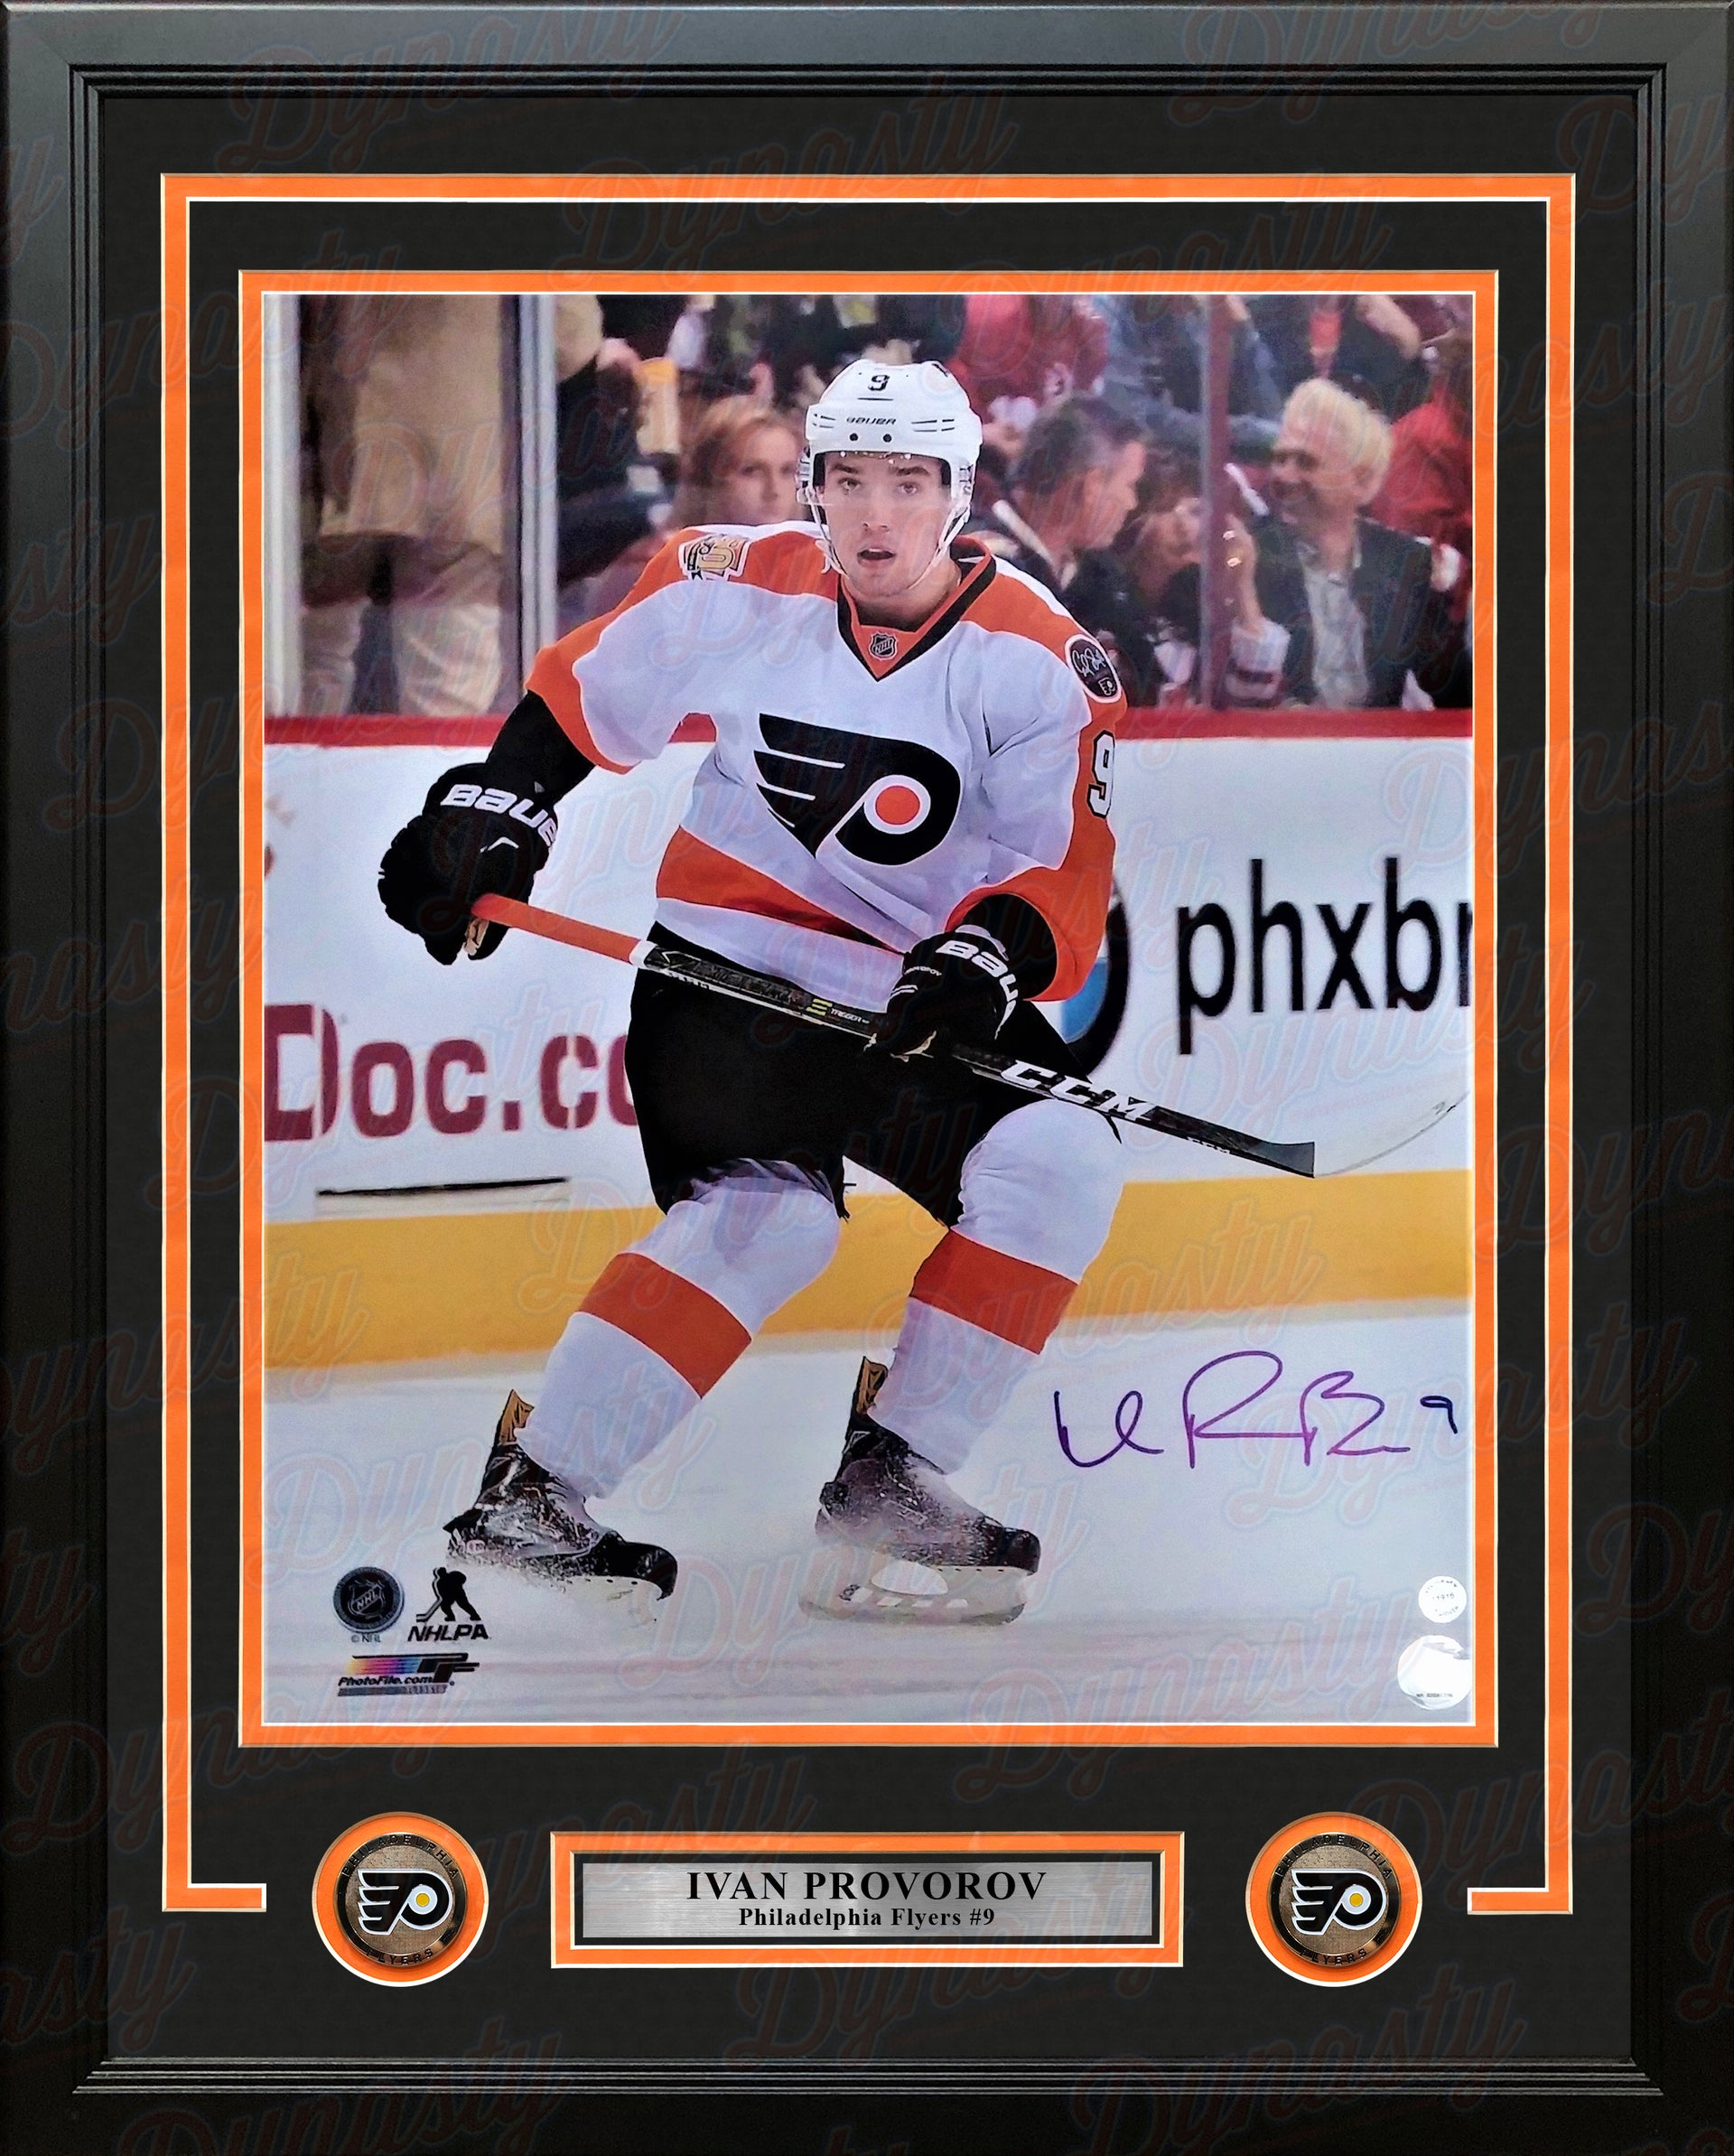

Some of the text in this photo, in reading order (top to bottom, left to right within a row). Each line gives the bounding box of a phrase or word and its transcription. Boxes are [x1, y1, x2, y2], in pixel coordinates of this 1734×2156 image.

[867, 374, 890, 392] 9
[1086, 731, 1115, 818] 9
[440, 784, 558, 847] BAUE
[1001, 1059, 1158, 1122] CCM
[407, 1624, 489, 1642] NHLPA
[342, 1834, 459, 1878] PHILADELPHIA
[1275, 1834, 1392, 1878] PHILADELPHIA
[689, 1871, 1047, 1900] IVAN PROVOROV
[740, 1908, 994, 1930] Philadelphia Flyers #9
